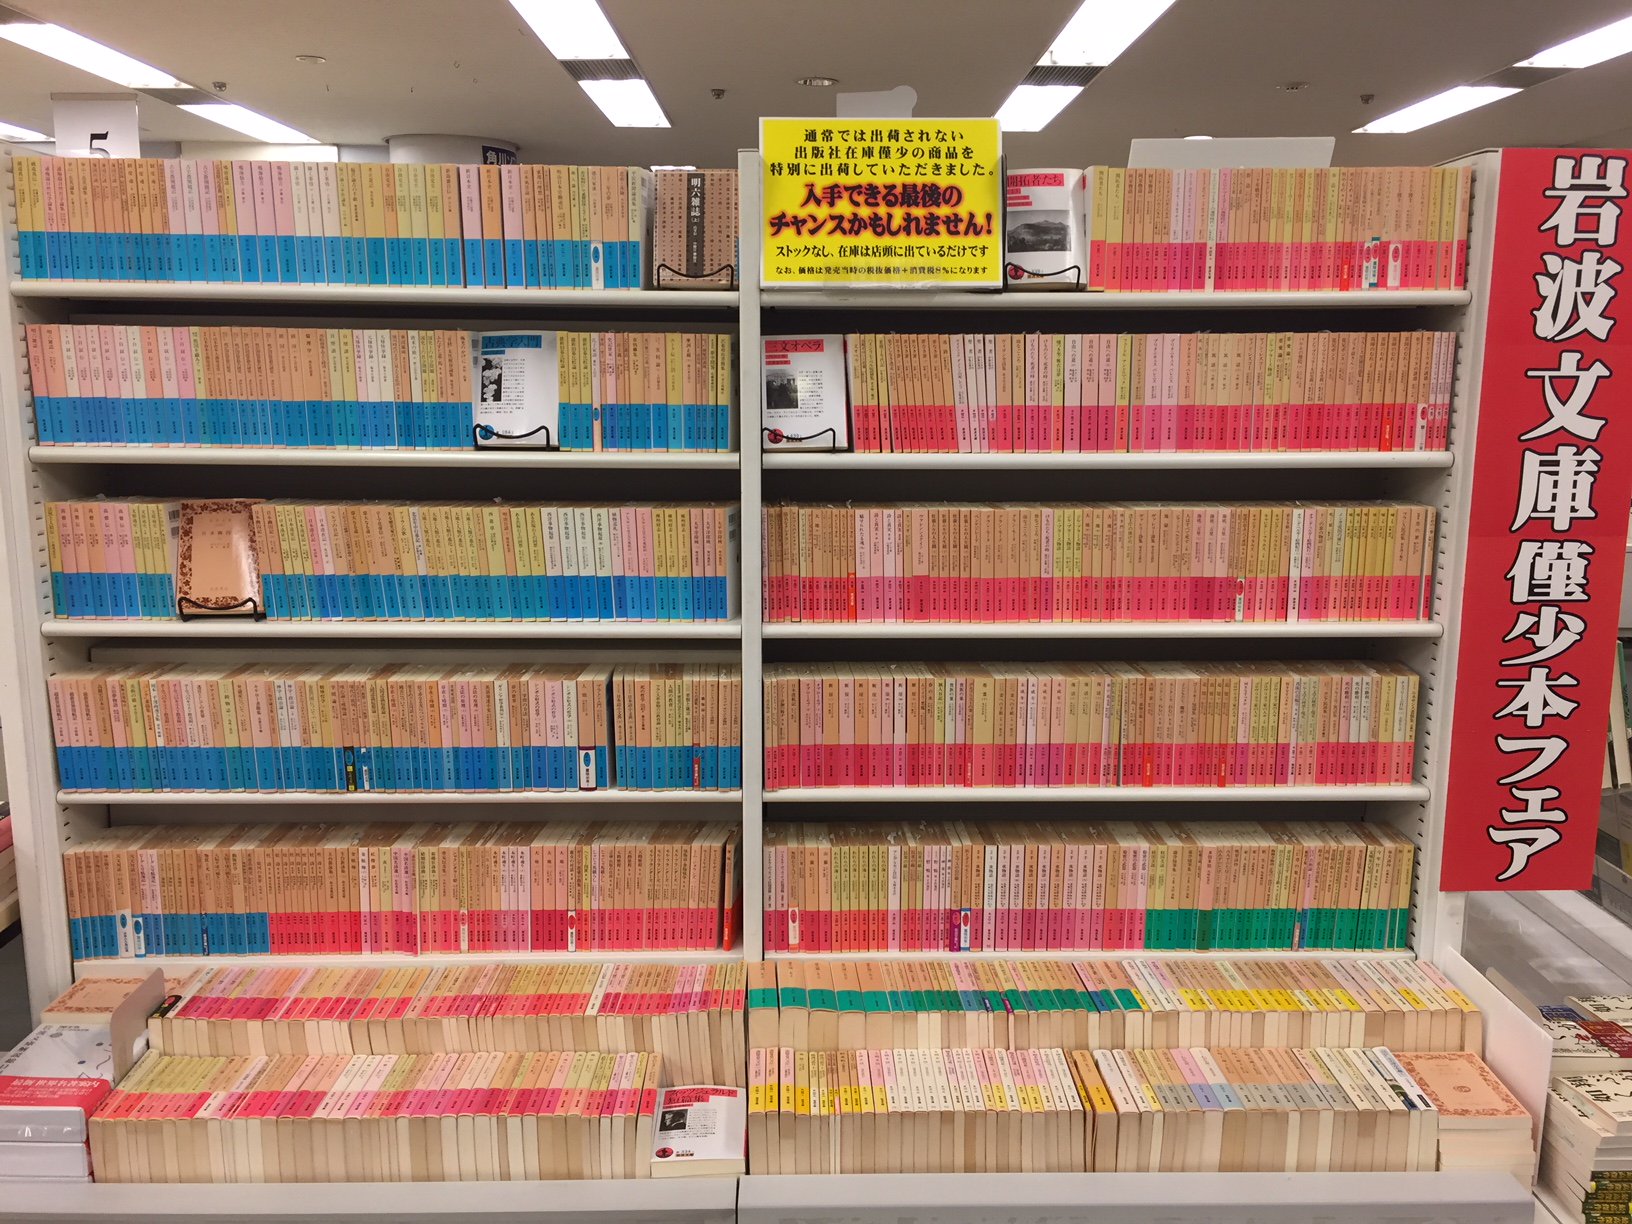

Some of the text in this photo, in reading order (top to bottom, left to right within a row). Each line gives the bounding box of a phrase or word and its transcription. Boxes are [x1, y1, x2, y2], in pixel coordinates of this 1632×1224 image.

[803, 129, 964, 142] 通常では出荷されない
[794, 146, 975, 159] 出版社在庫僅少の商品を
[770, 162, 995, 176] 特別に出荷していただきました。
[690, 177, 701, 216] 明六雑誌
[801, 183, 962, 207] 入手できる最後の
[769, 212, 993, 236] チャンスかもしれません！
[775, 245, 989, 258] ストックなし、在庫は店頭に出ているだけです
[766, 340, 822, 352] 三文オペラ
[1486, 154, 1629, 882] 岩波文庫僅少本フェア
